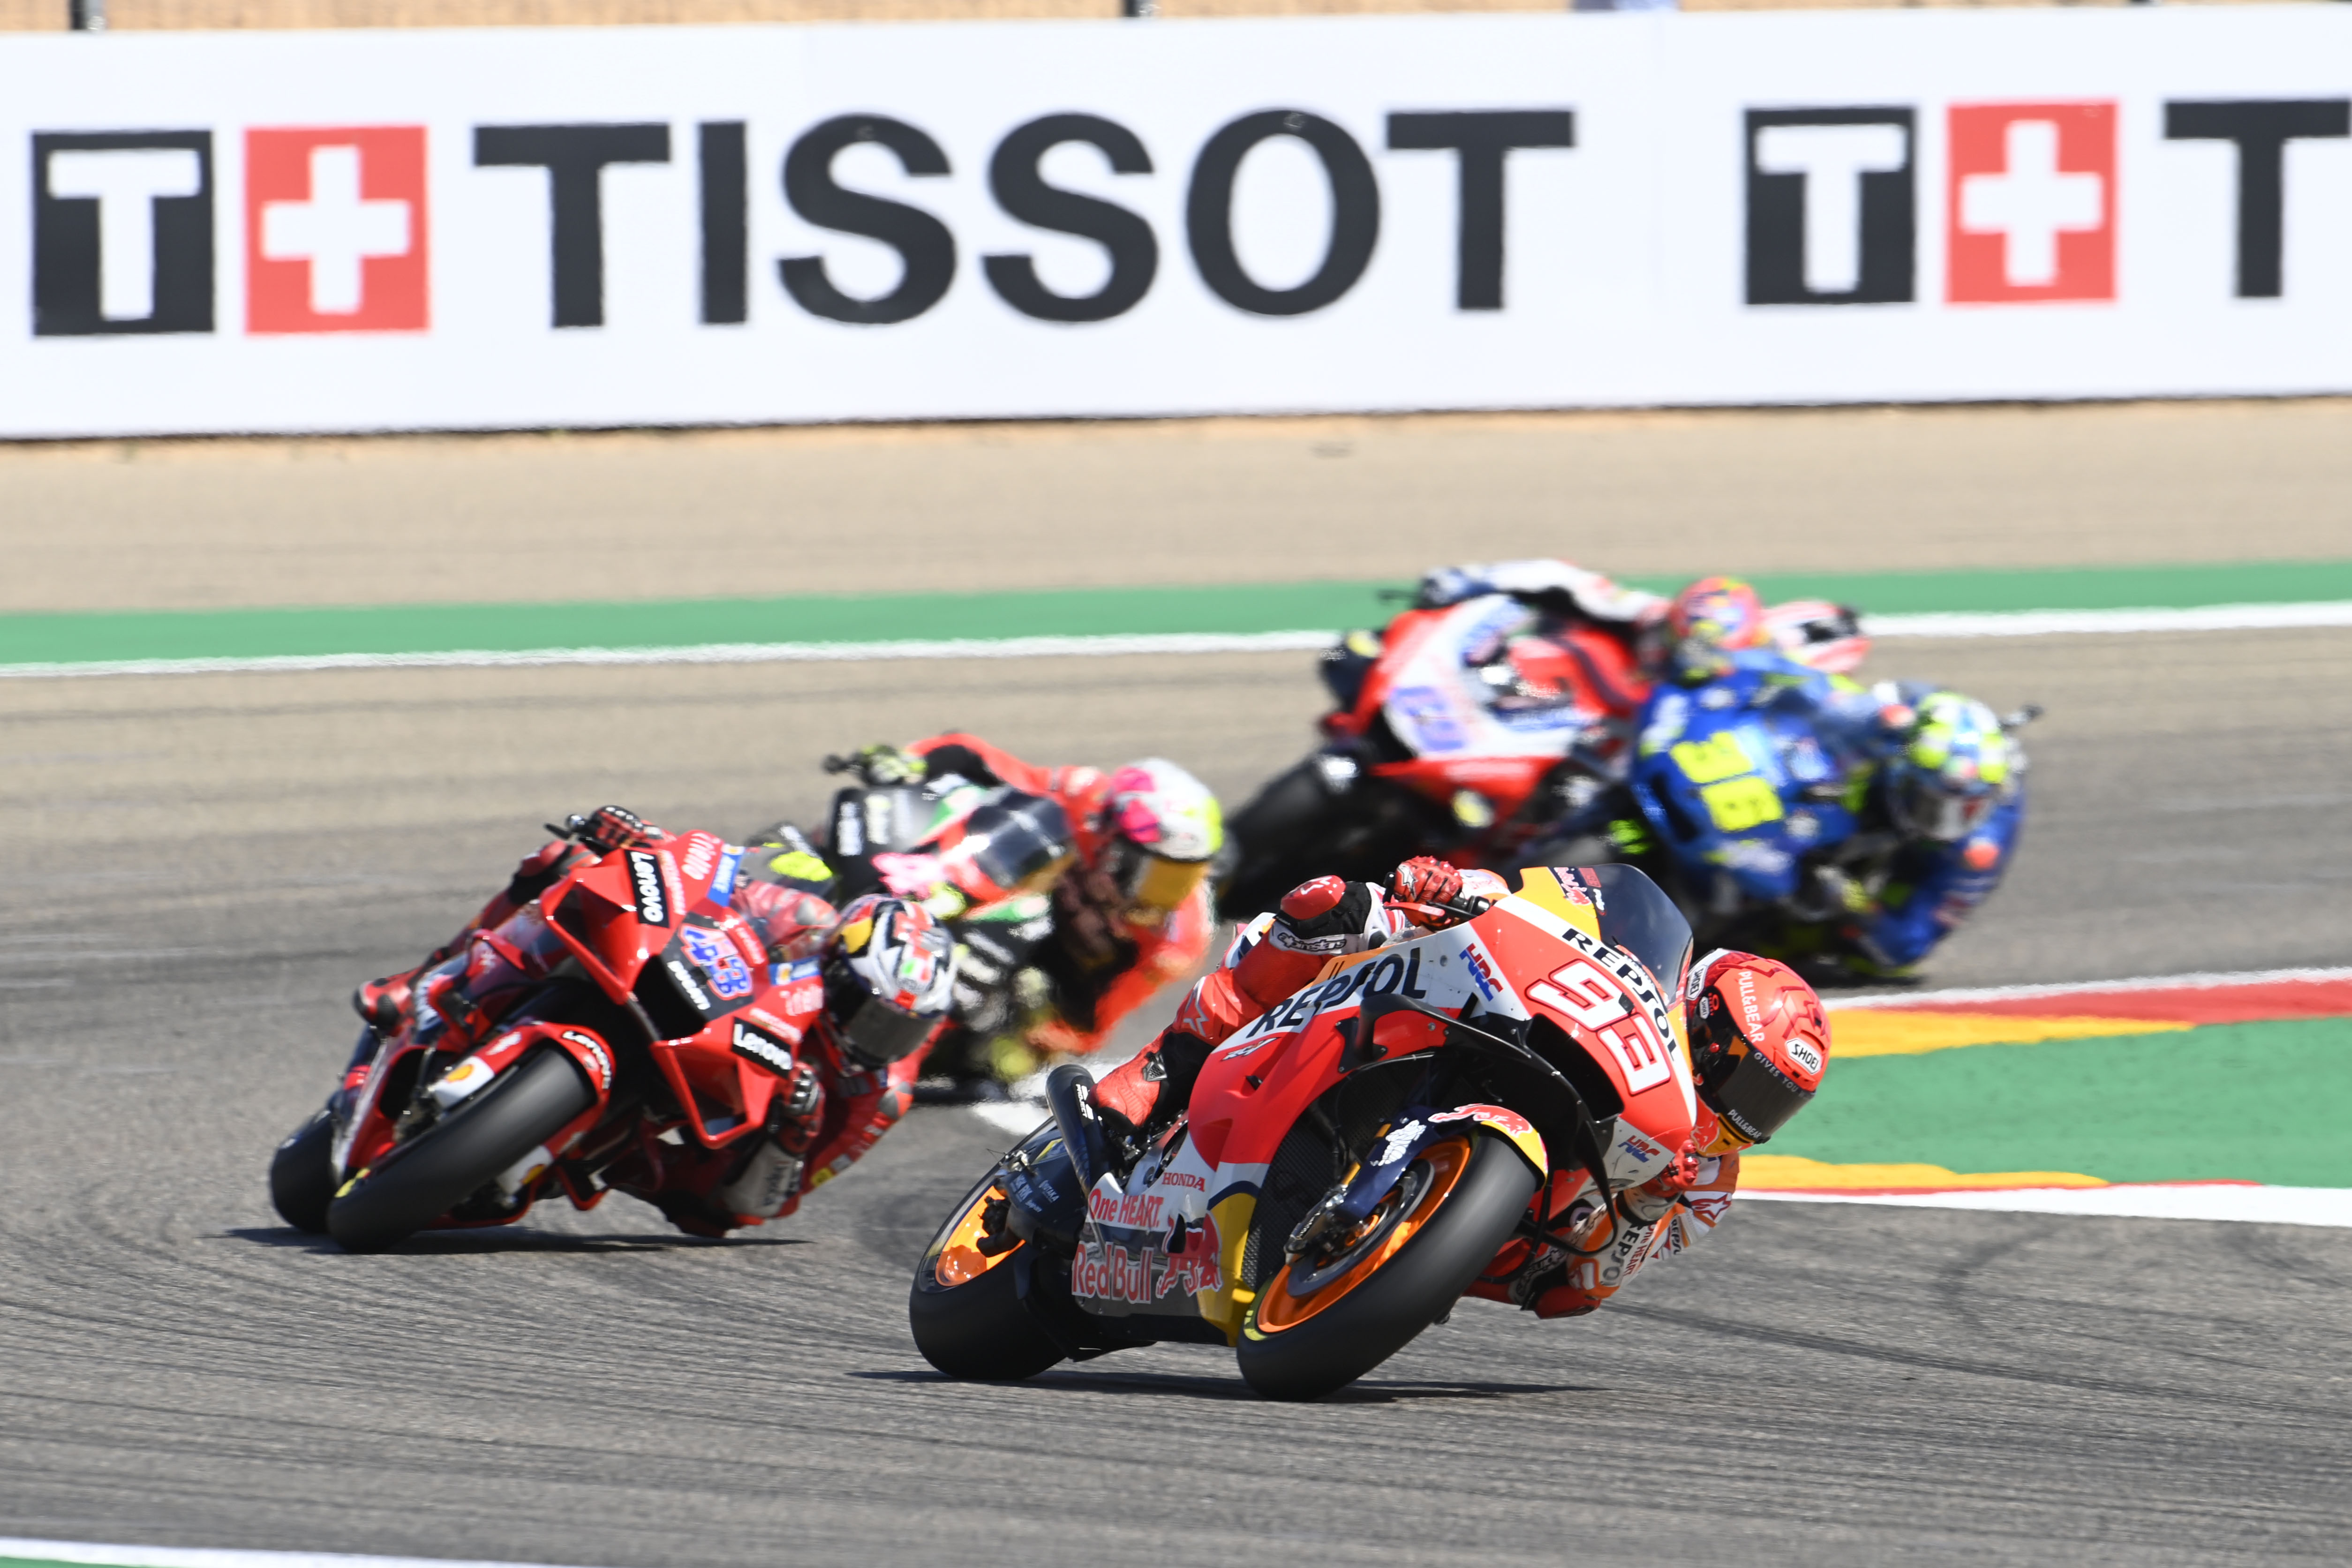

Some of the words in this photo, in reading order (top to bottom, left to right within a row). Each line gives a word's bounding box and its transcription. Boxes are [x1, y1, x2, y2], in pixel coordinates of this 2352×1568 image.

[474, 106, 1576, 329] TISSOT
[630, 851, 665, 923] Lenovo
[1277, 932, 1347, 952] alpinestars
[1245, 946, 1426, 1038] REPSOL
[1562, 928, 1676, 1061] REPSOL
[1738, 970, 1765, 1043] PULL&BEAR
[734, 1023, 793, 1070] Lenovo
[1525, 959, 1671, 1096] 93
[1754, 1052, 1781, 1077] GIVES
[1791, 1043, 1819, 1070] SHOEI
[1782, 1077, 1799, 1092] YOU
[1727, 1109, 1762, 1138] PULL&BEAR
[1161, 1172, 1206, 1192] HONDA
[1089, 1188, 1118, 1221] One
